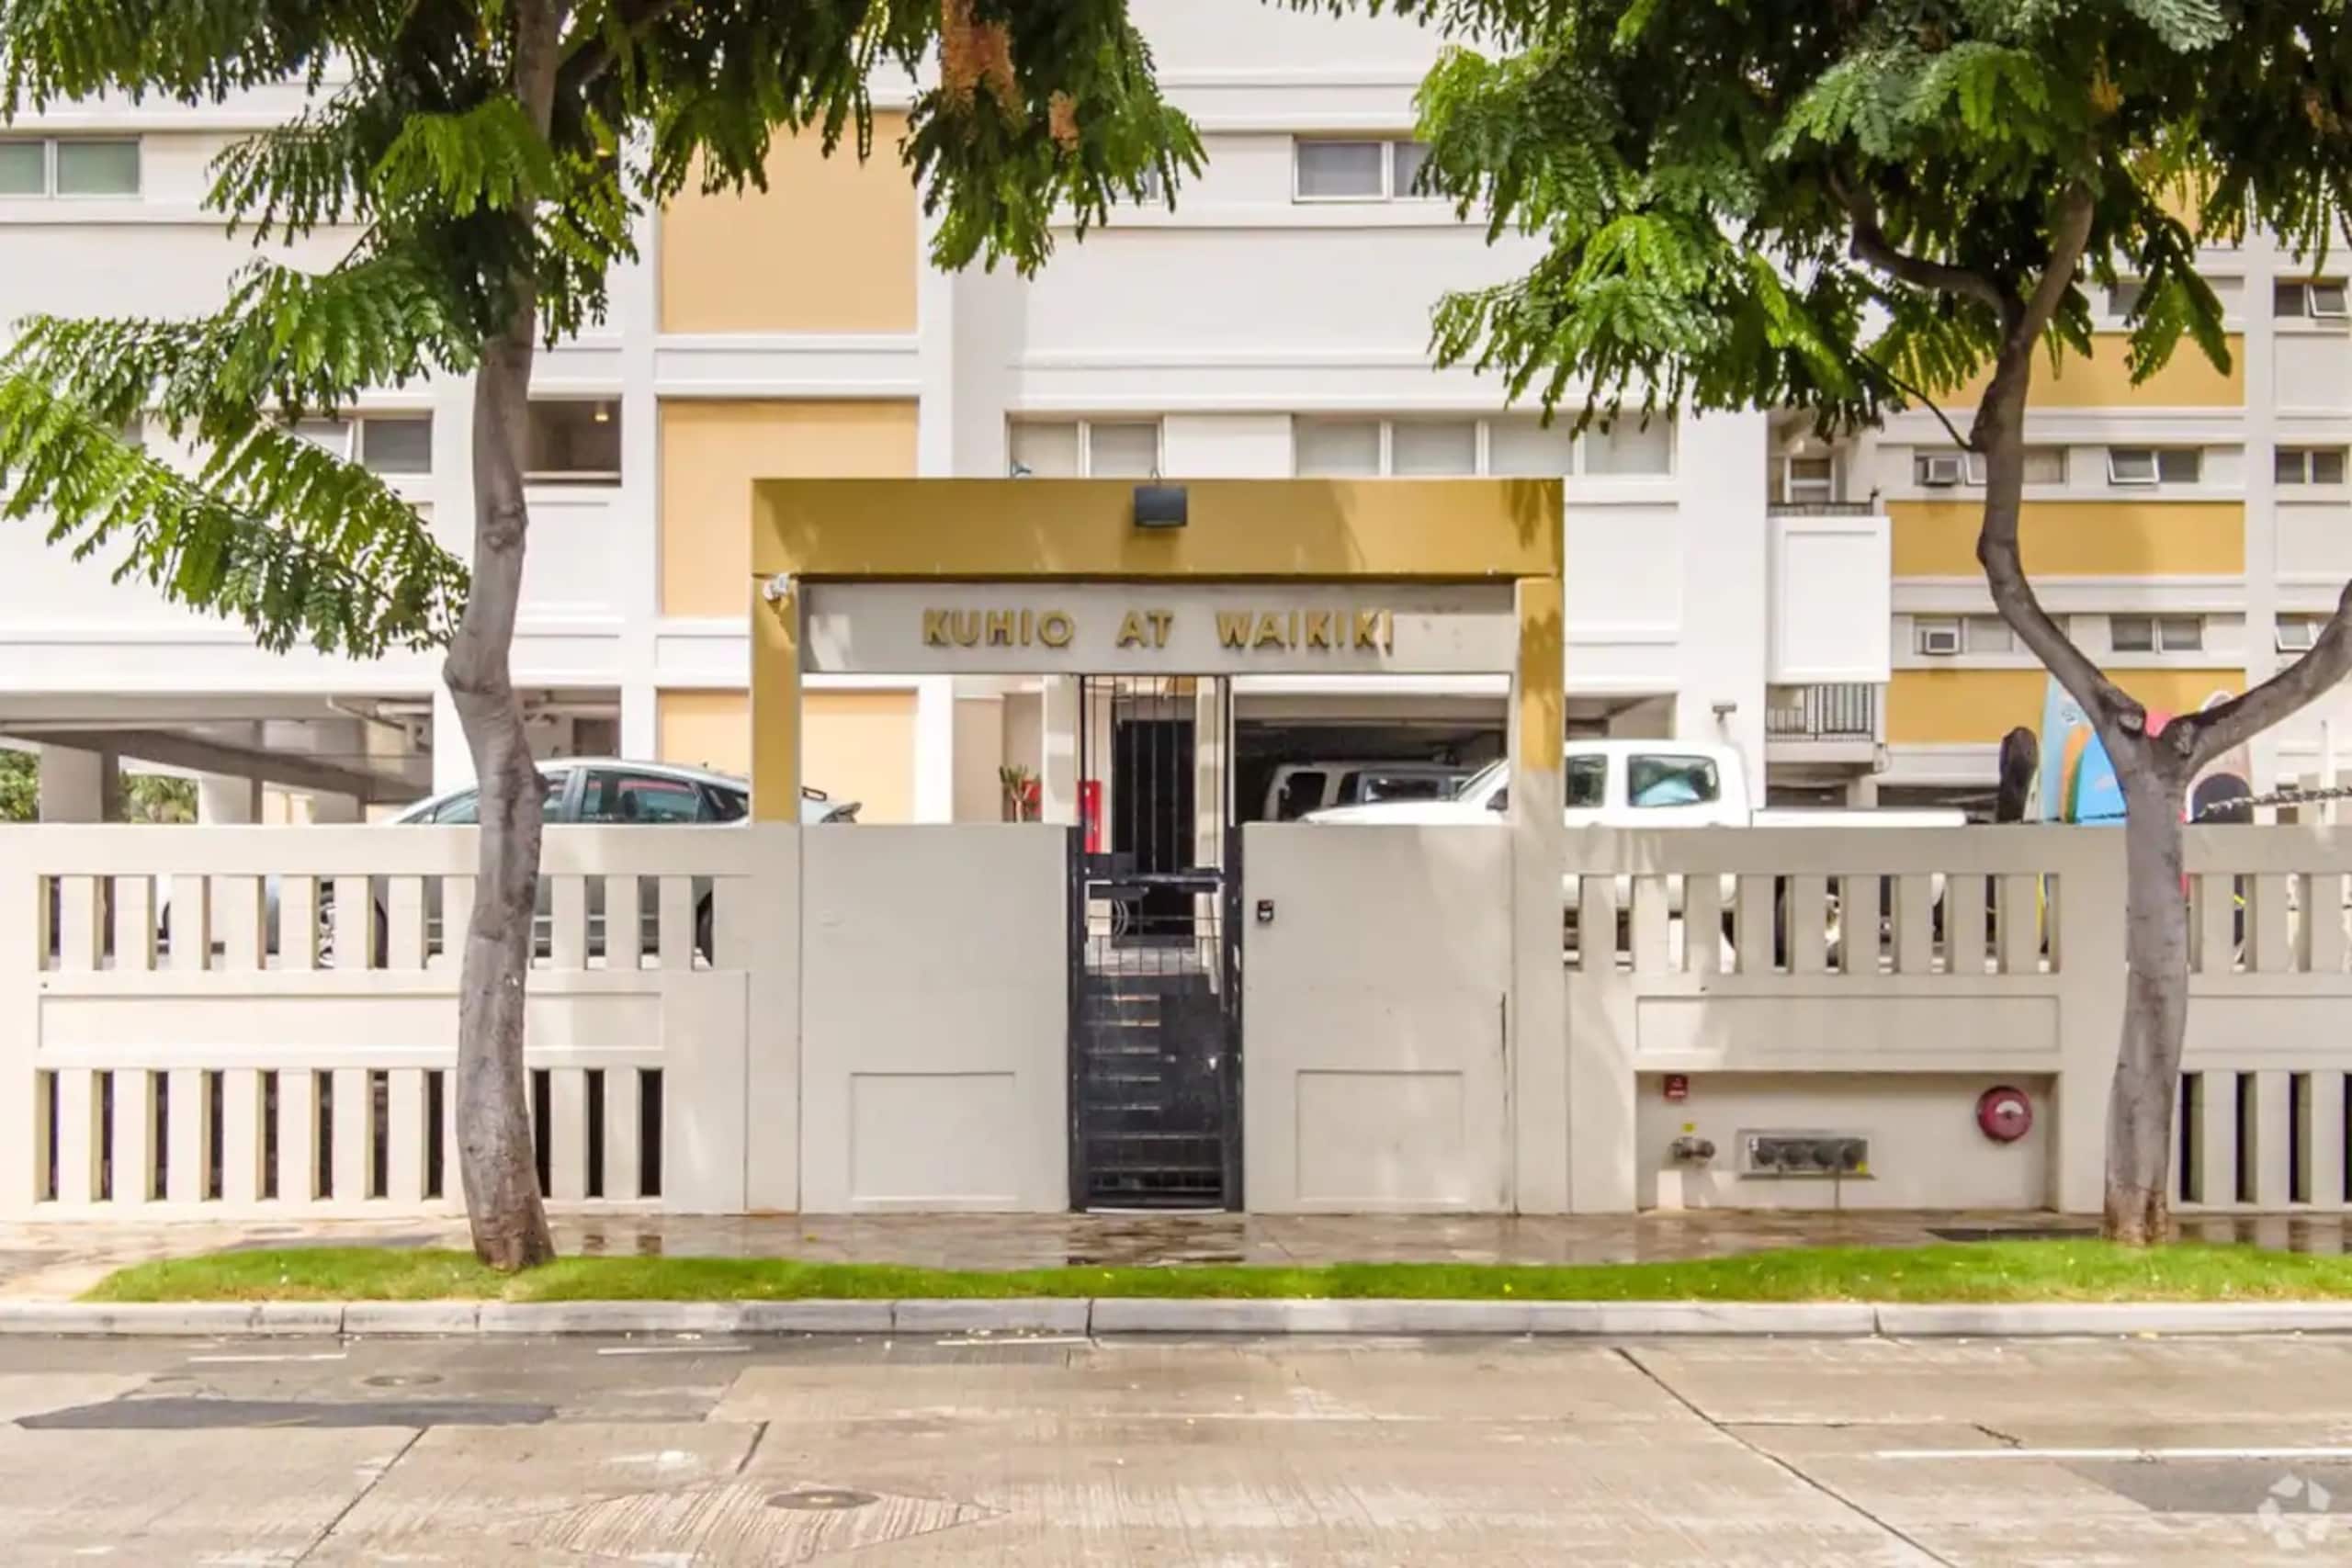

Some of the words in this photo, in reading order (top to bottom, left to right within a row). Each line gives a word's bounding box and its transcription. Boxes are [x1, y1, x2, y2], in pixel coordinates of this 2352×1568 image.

[922, 608, 1074, 648] KUHIO
[1115, 608, 1175, 648] AT
[1216, 608, 1394, 650] WAIKIKI
